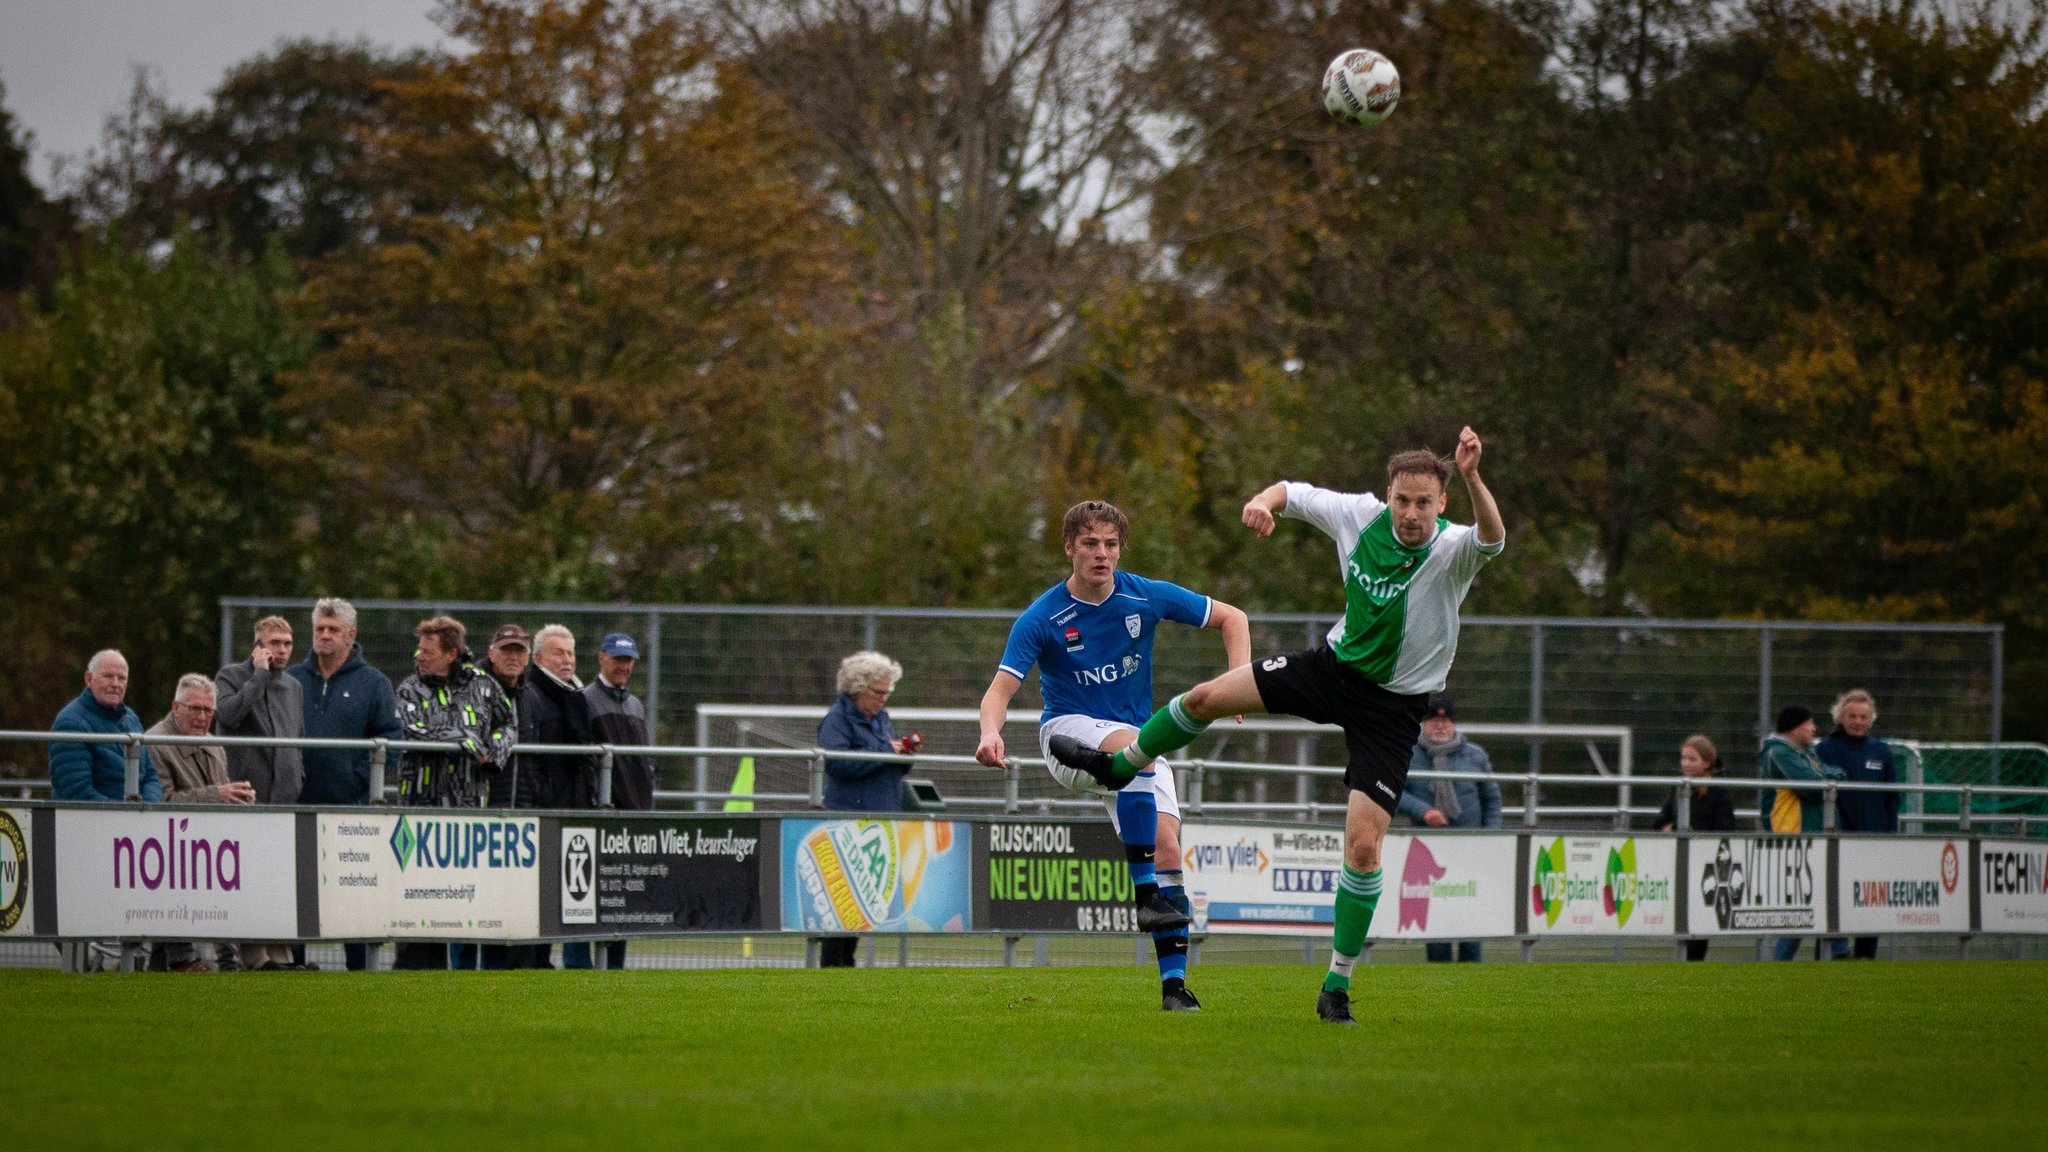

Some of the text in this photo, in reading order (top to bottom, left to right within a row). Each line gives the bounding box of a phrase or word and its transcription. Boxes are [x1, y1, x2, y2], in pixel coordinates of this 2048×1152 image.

[1056, 610, 1078, 627] hummel
[1072, 664, 1118, 686] ING
[1262, 656, 1287, 672] 3
[338, 822, 380, 837] nieuwbouw
[990, 824, 1075, 853] RIJSCHOOL
[113, 817, 241, 891] nolina
[338, 848, 370, 863] verbouw
[416, 821, 536, 869] KUIJPERS
[600, 827, 758, 862] Loek van Vliet, keurslager
[1194, 844, 1223, 873] van
[1227, 840, 1259, 873] vliet
[338, 873, 378, 887] onderhoud
[568, 852, 589, 893] K
[1275, 869, 1340, 893] AUTO'S
[1744, 838, 1813, 906] VITTERS
[404, 884, 476, 903] aannemersbedrijf
[125, 903, 229, 925] growers with passion
[1077, 906, 1094, 932] 06
[1094, 907, 1112, 932] 34
[1112, 907, 1129, 932] 03
